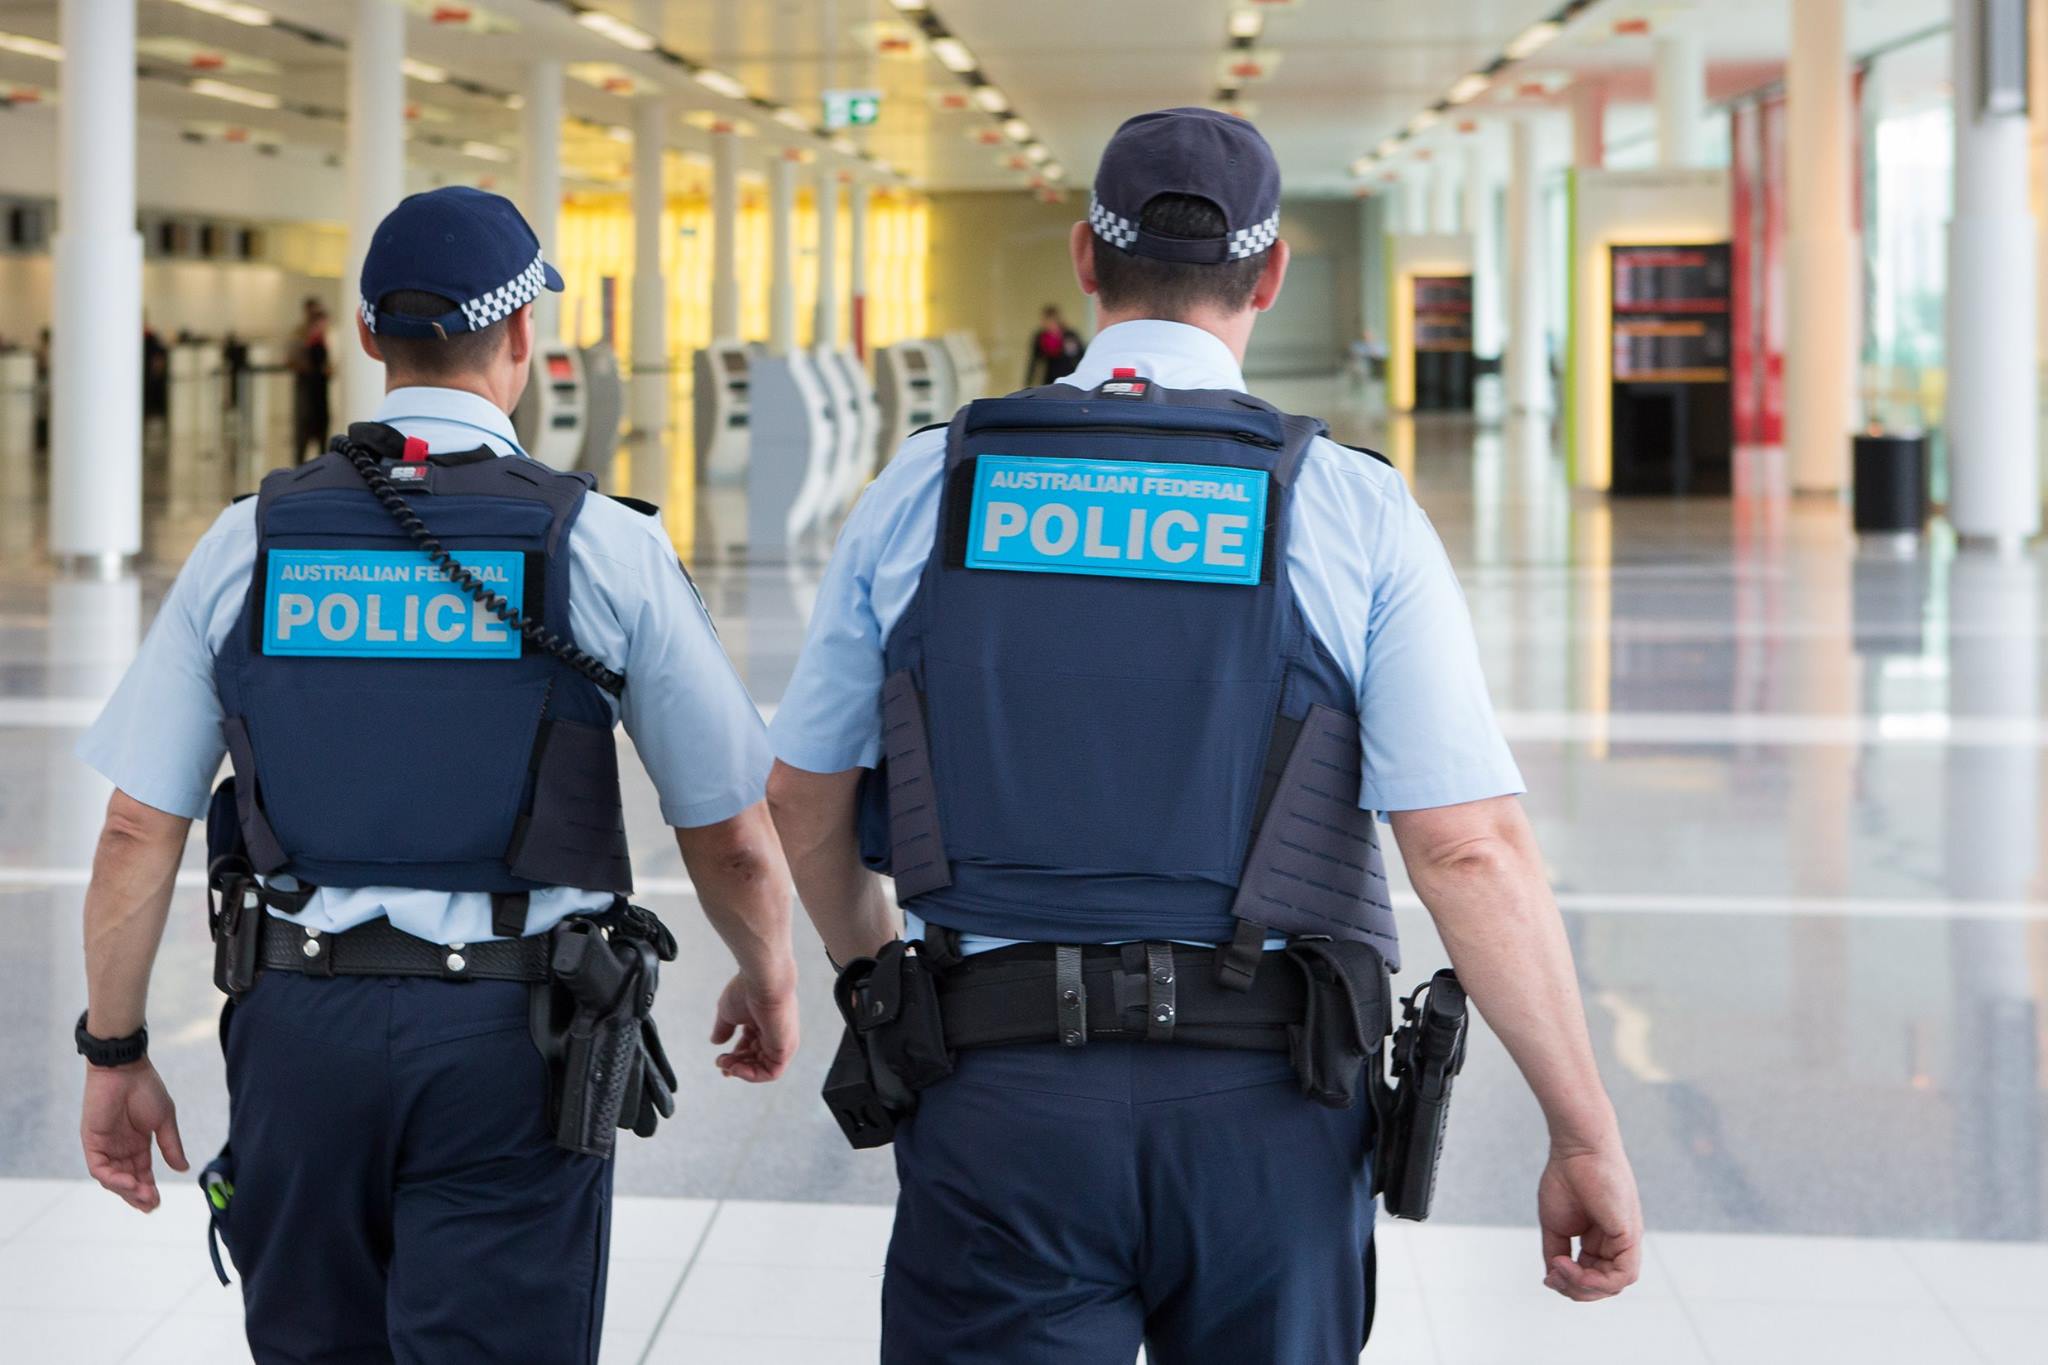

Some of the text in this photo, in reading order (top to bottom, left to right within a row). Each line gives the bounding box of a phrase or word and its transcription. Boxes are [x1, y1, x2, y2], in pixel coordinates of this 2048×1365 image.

[990, 470, 1251, 502] AUSTRALIAN FEDERAL
[982, 501, 1249, 567] POLICE
[281, 564, 509, 583] AUSTRALIAN FERAL
[276, 592, 508, 643] POLICE
